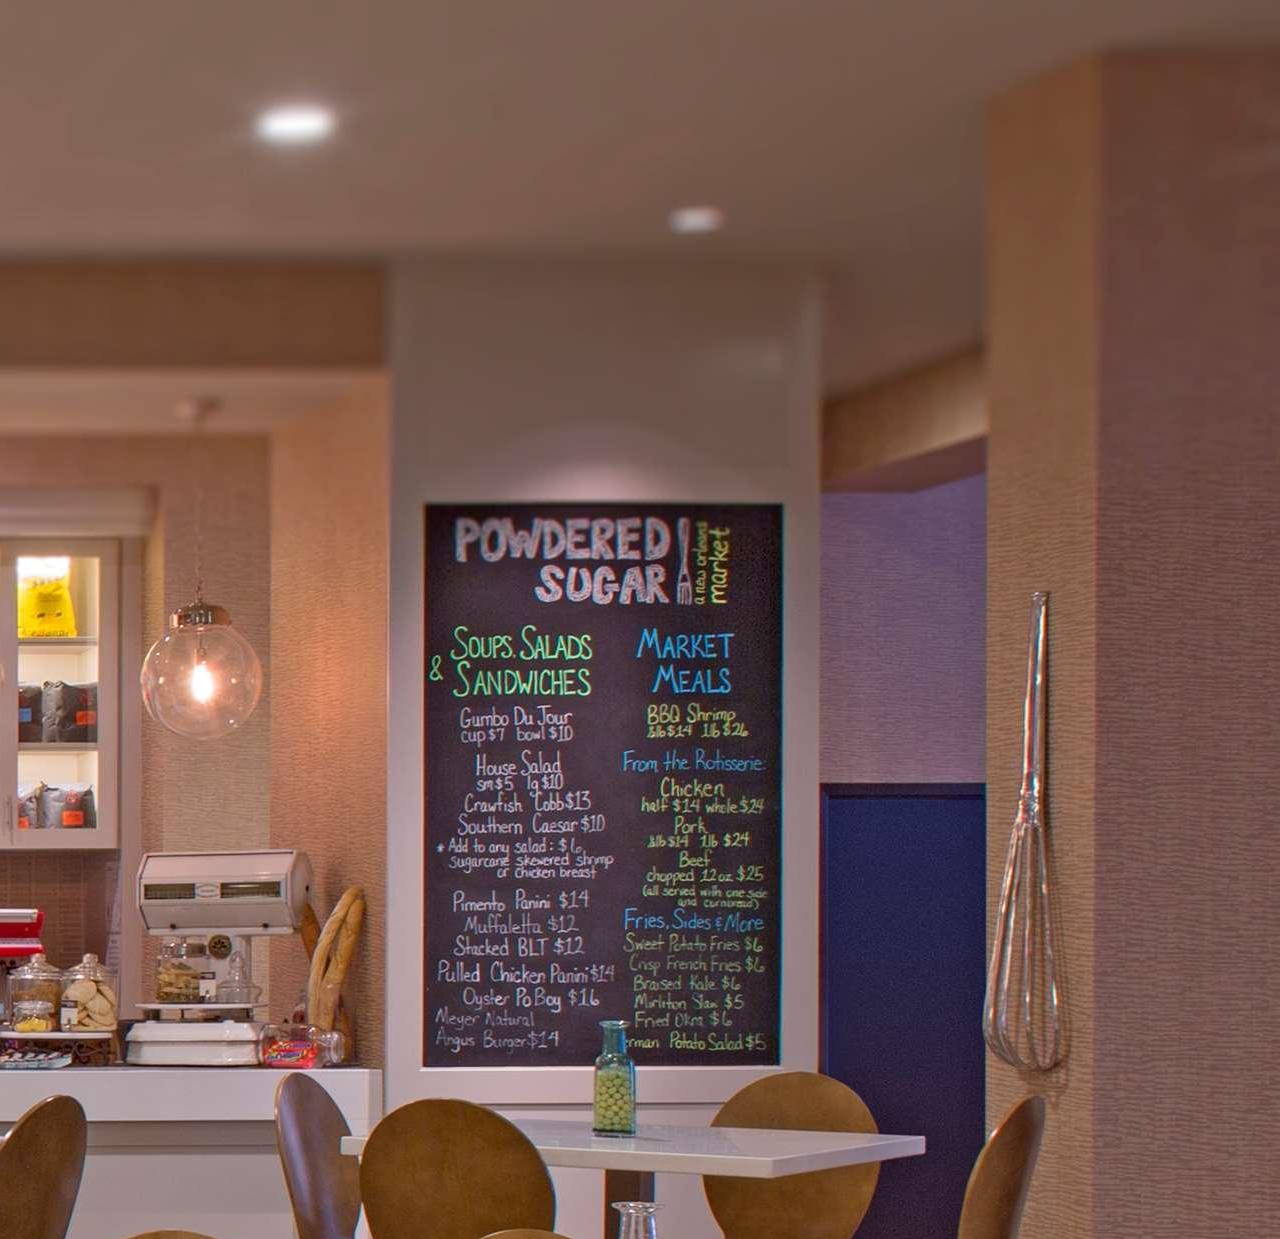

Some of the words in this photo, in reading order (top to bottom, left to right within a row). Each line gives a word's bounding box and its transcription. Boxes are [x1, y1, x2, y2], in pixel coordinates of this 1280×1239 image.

[454, 517, 672, 563] POWDERED
[708, 527, 729, 603] market
[534, 565, 669, 605] SUGAR
[519, 625, 593, 661] SALADS
[636, 627, 735, 659] MARKET
[429, 655, 443, 681] &
[452, 660, 591, 697] SANDWICHES
[652, 663, 732, 694] MEALS
[459, 706, 509, 728] Gumbo
[513, 705, 534, 726] Du
[537, 704, 573, 726] Jour
[647, 703, 680, 725] BBQ
[687, 702, 737, 724] Shrimp
[460, 731, 486, 748] cup
[488, 727, 506, 742] $7
[516, 726, 546, 742] bowl
[548, 725, 573, 743] $10
[476, 753, 518, 776] House
[520, 749, 562, 774] Salad
[622, 749, 658, 773] From
[663, 749, 690, 772] the
[476, 778, 494, 791] sm
[495, 775, 514, 791] $5
[541, 774, 564, 791] $10
[660, 777, 725, 798] Chicken
[464, 791, 523, 813] Crawfish
[534, 791, 564, 812] Cobb
[564, 790, 591, 810] $13
[641, 796, 668, 813] half
[673, 799, 700, 814] $14
[705, 797, 739, 814] whole
[458, 813, 523, 836] Southern
[532, 813, 579, 834] Caesar
[580, 814, 606, 834] $10
[675, 815, 708, 835] Pork
[449, 838, 468, 853] Add
[473, 838, 485, 853] to
[488, 843, 510, 858] any
[558, 838, 582, 853] $6
[723, 831, 750, 848] $24
[449, 855, 510, 873] sugarcane
[515, 853, 569, 867] skewered
[575, 851, 615, 869] shrimp
[679, 850, 713, 868] Beef
[497, 868, 508, 878] or
[515, 867, 556, 878] chicken
[559, 867, 597, 878] breast
[646, 866, 695, 886] chopped
[700, 869, 717, 882] 12
[736, 865, 764, 882] $25
[453, 890, 506, 912] Pimento
[515, 889, 550, 910] Panini
[559, 889, 589, 909] $14
[662, 885, 695, 897] served
[700, 885, 722, 897] with
[725, 889, 744, 898] one
[548, 914, 580, 933] $12
[624, 907, 669, 931] Fries,
[672, 907, 711, 930] Sides
[724, 912, 765, 932] More
[453, 935, 509, 956] Stacked
[518, 937, 549, 956] BLT
[553, 936, 585, 955] $12
[623, 932, 665, 952] Sweet
[668, 933, 706, 952] Potato
[709, 935, 740, 951] Fries
[744, 936, 764, 953] $6
[437, 960, 480, 983] Pulled
[490, 961, 546, 984] Chicken
[550, 963, 589, 984] Panini
[590, 963, 615, 983] $14
[629, 953, 661, 976] Crisp
[666, 955, 706, 971] French
[711, 955, 741, 972] Fries
[744, 956, 765, 973] $6
[633, 975, 682, 992] Braised
[689, 975, 716, 991] Kale
[721, 975, 741, 991] $6
[463, 987, 510, 1010] Oyster
[568, 988, 600, 1007] $16
[724, 993, 745, 1010] $5
[435, 1006, 481, 1030] Meyer
[485, 1011, 534, 1028] Natural
[635, 1011, 670, 1028] Fried
[675, 1012, 704, 1028] Okra
[708, 1011, 733, 1027] $6
[436, 1027, 475, 1053] Angus
[483, 1030, 528, 1053] Burger
[670, 1030, 706, 1050] Potato
[708, 1032, 742, 1050] Salad
[744, 1032, 767, 1050] $5
